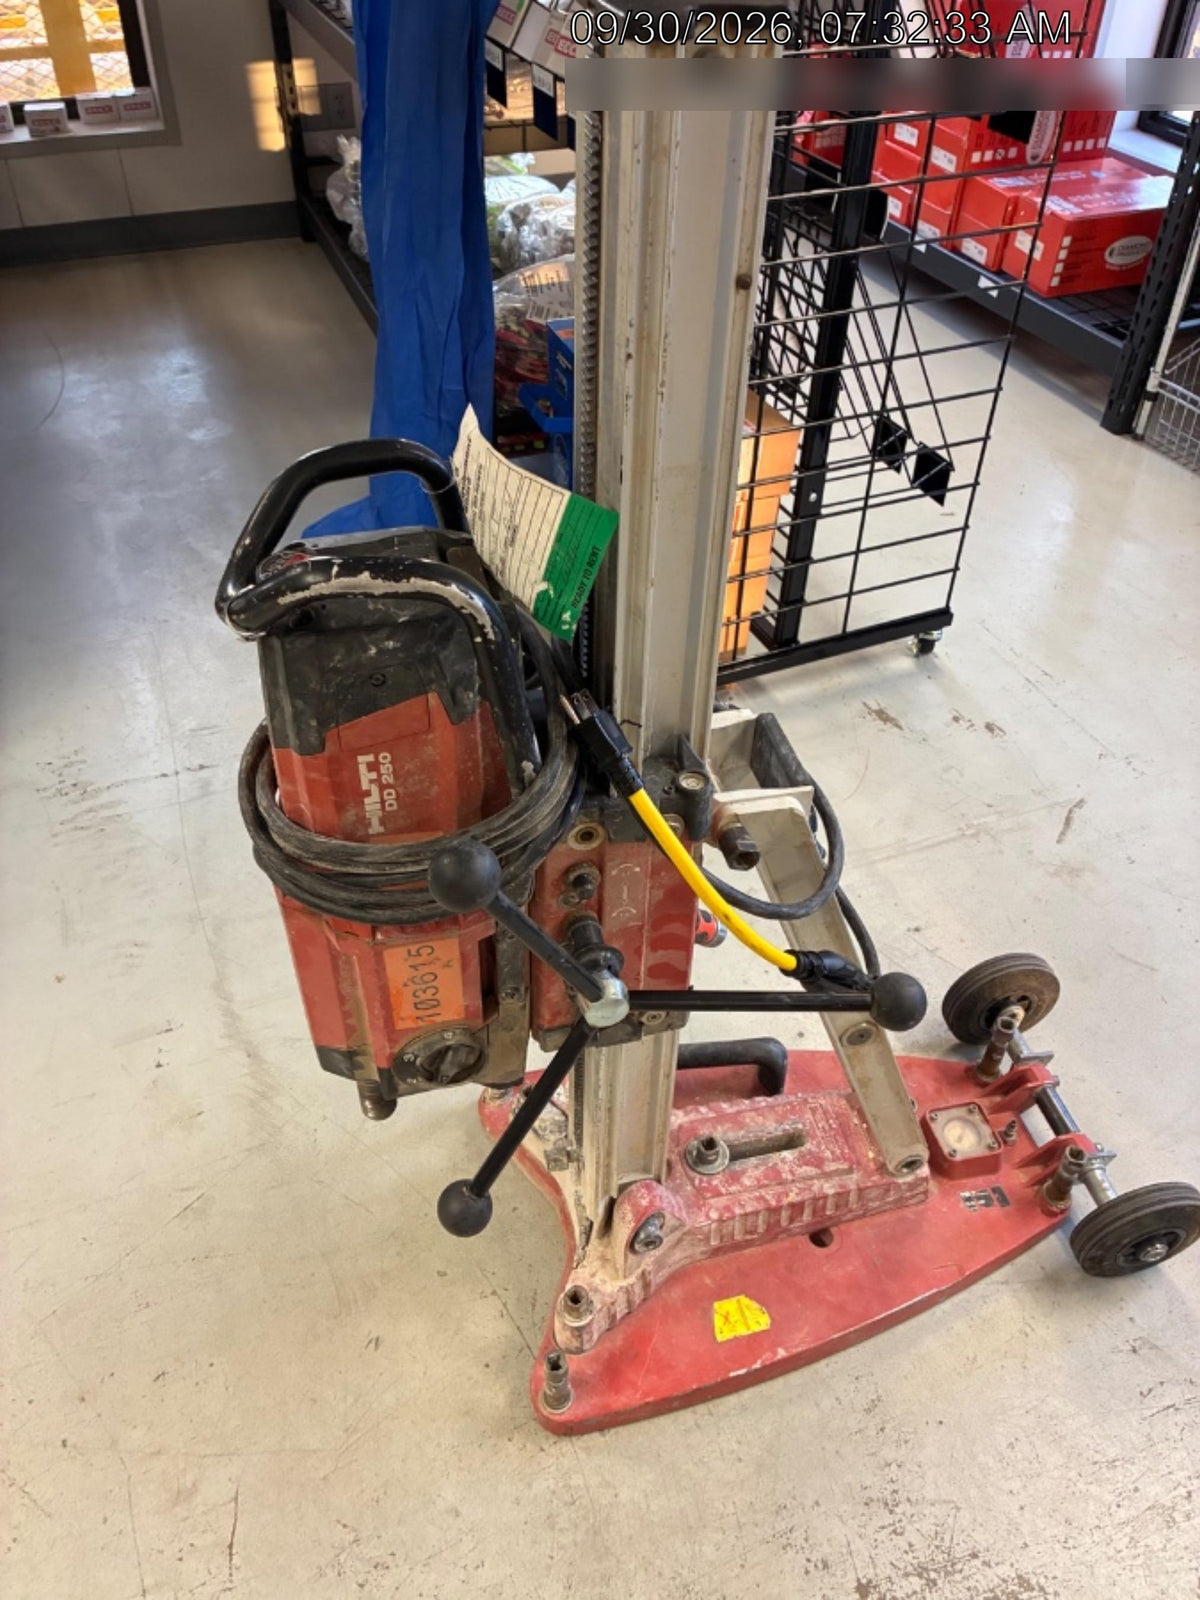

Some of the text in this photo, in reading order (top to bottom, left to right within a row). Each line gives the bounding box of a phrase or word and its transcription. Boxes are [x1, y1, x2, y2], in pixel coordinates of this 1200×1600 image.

[582, 568, 593, 581] TO
[586, 544, 601, 569] RENT
[570, 581, 588, 609] READY
[357, 753, 385, 834] HILTI
[378, 751, 398, 812] DD 250
[406, 944, 442, 1024] 103615
